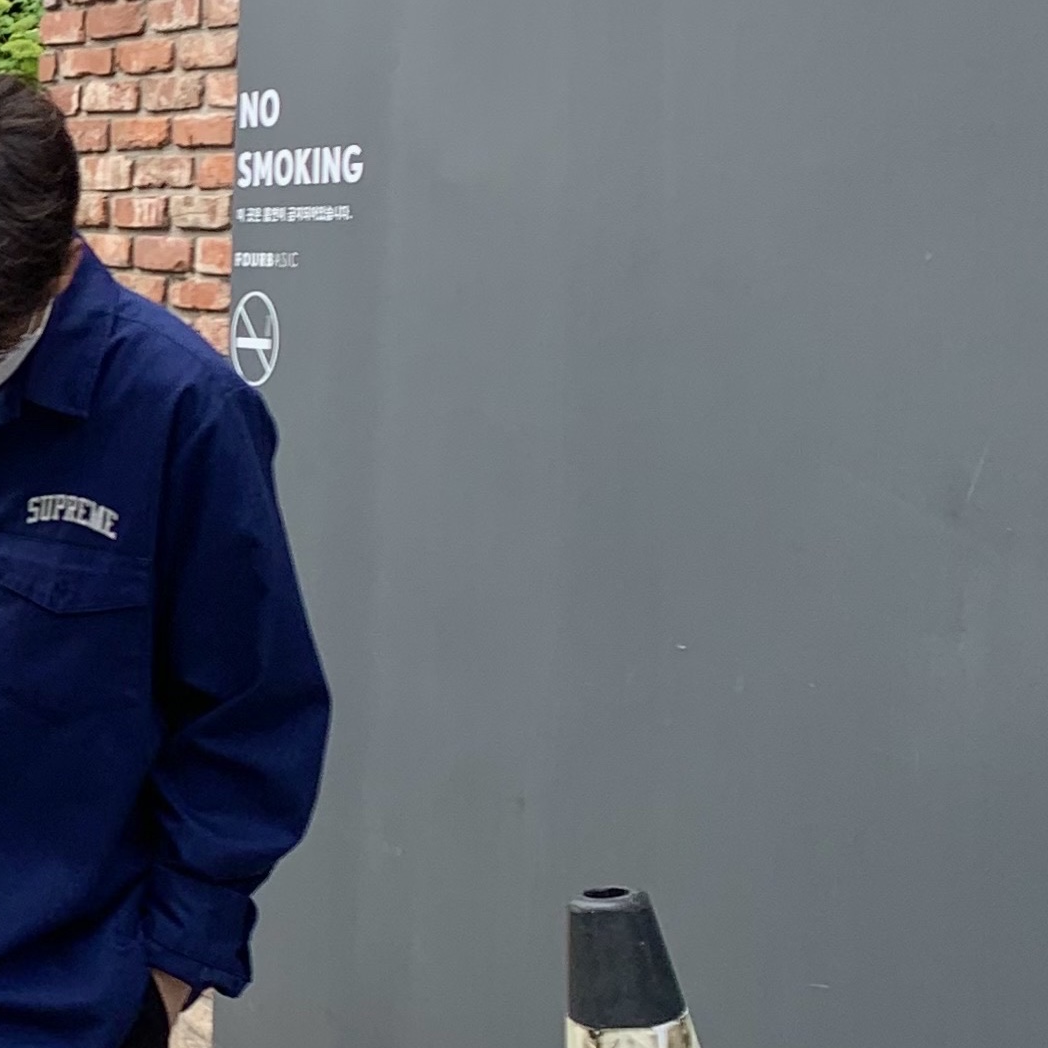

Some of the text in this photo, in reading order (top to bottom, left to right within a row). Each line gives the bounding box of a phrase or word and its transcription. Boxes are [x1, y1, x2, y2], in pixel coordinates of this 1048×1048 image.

[239, 89, 280, 128] NO
[237, 145, 363, 187] SMOKING
[26, 494, 119, 540] SUPREME
